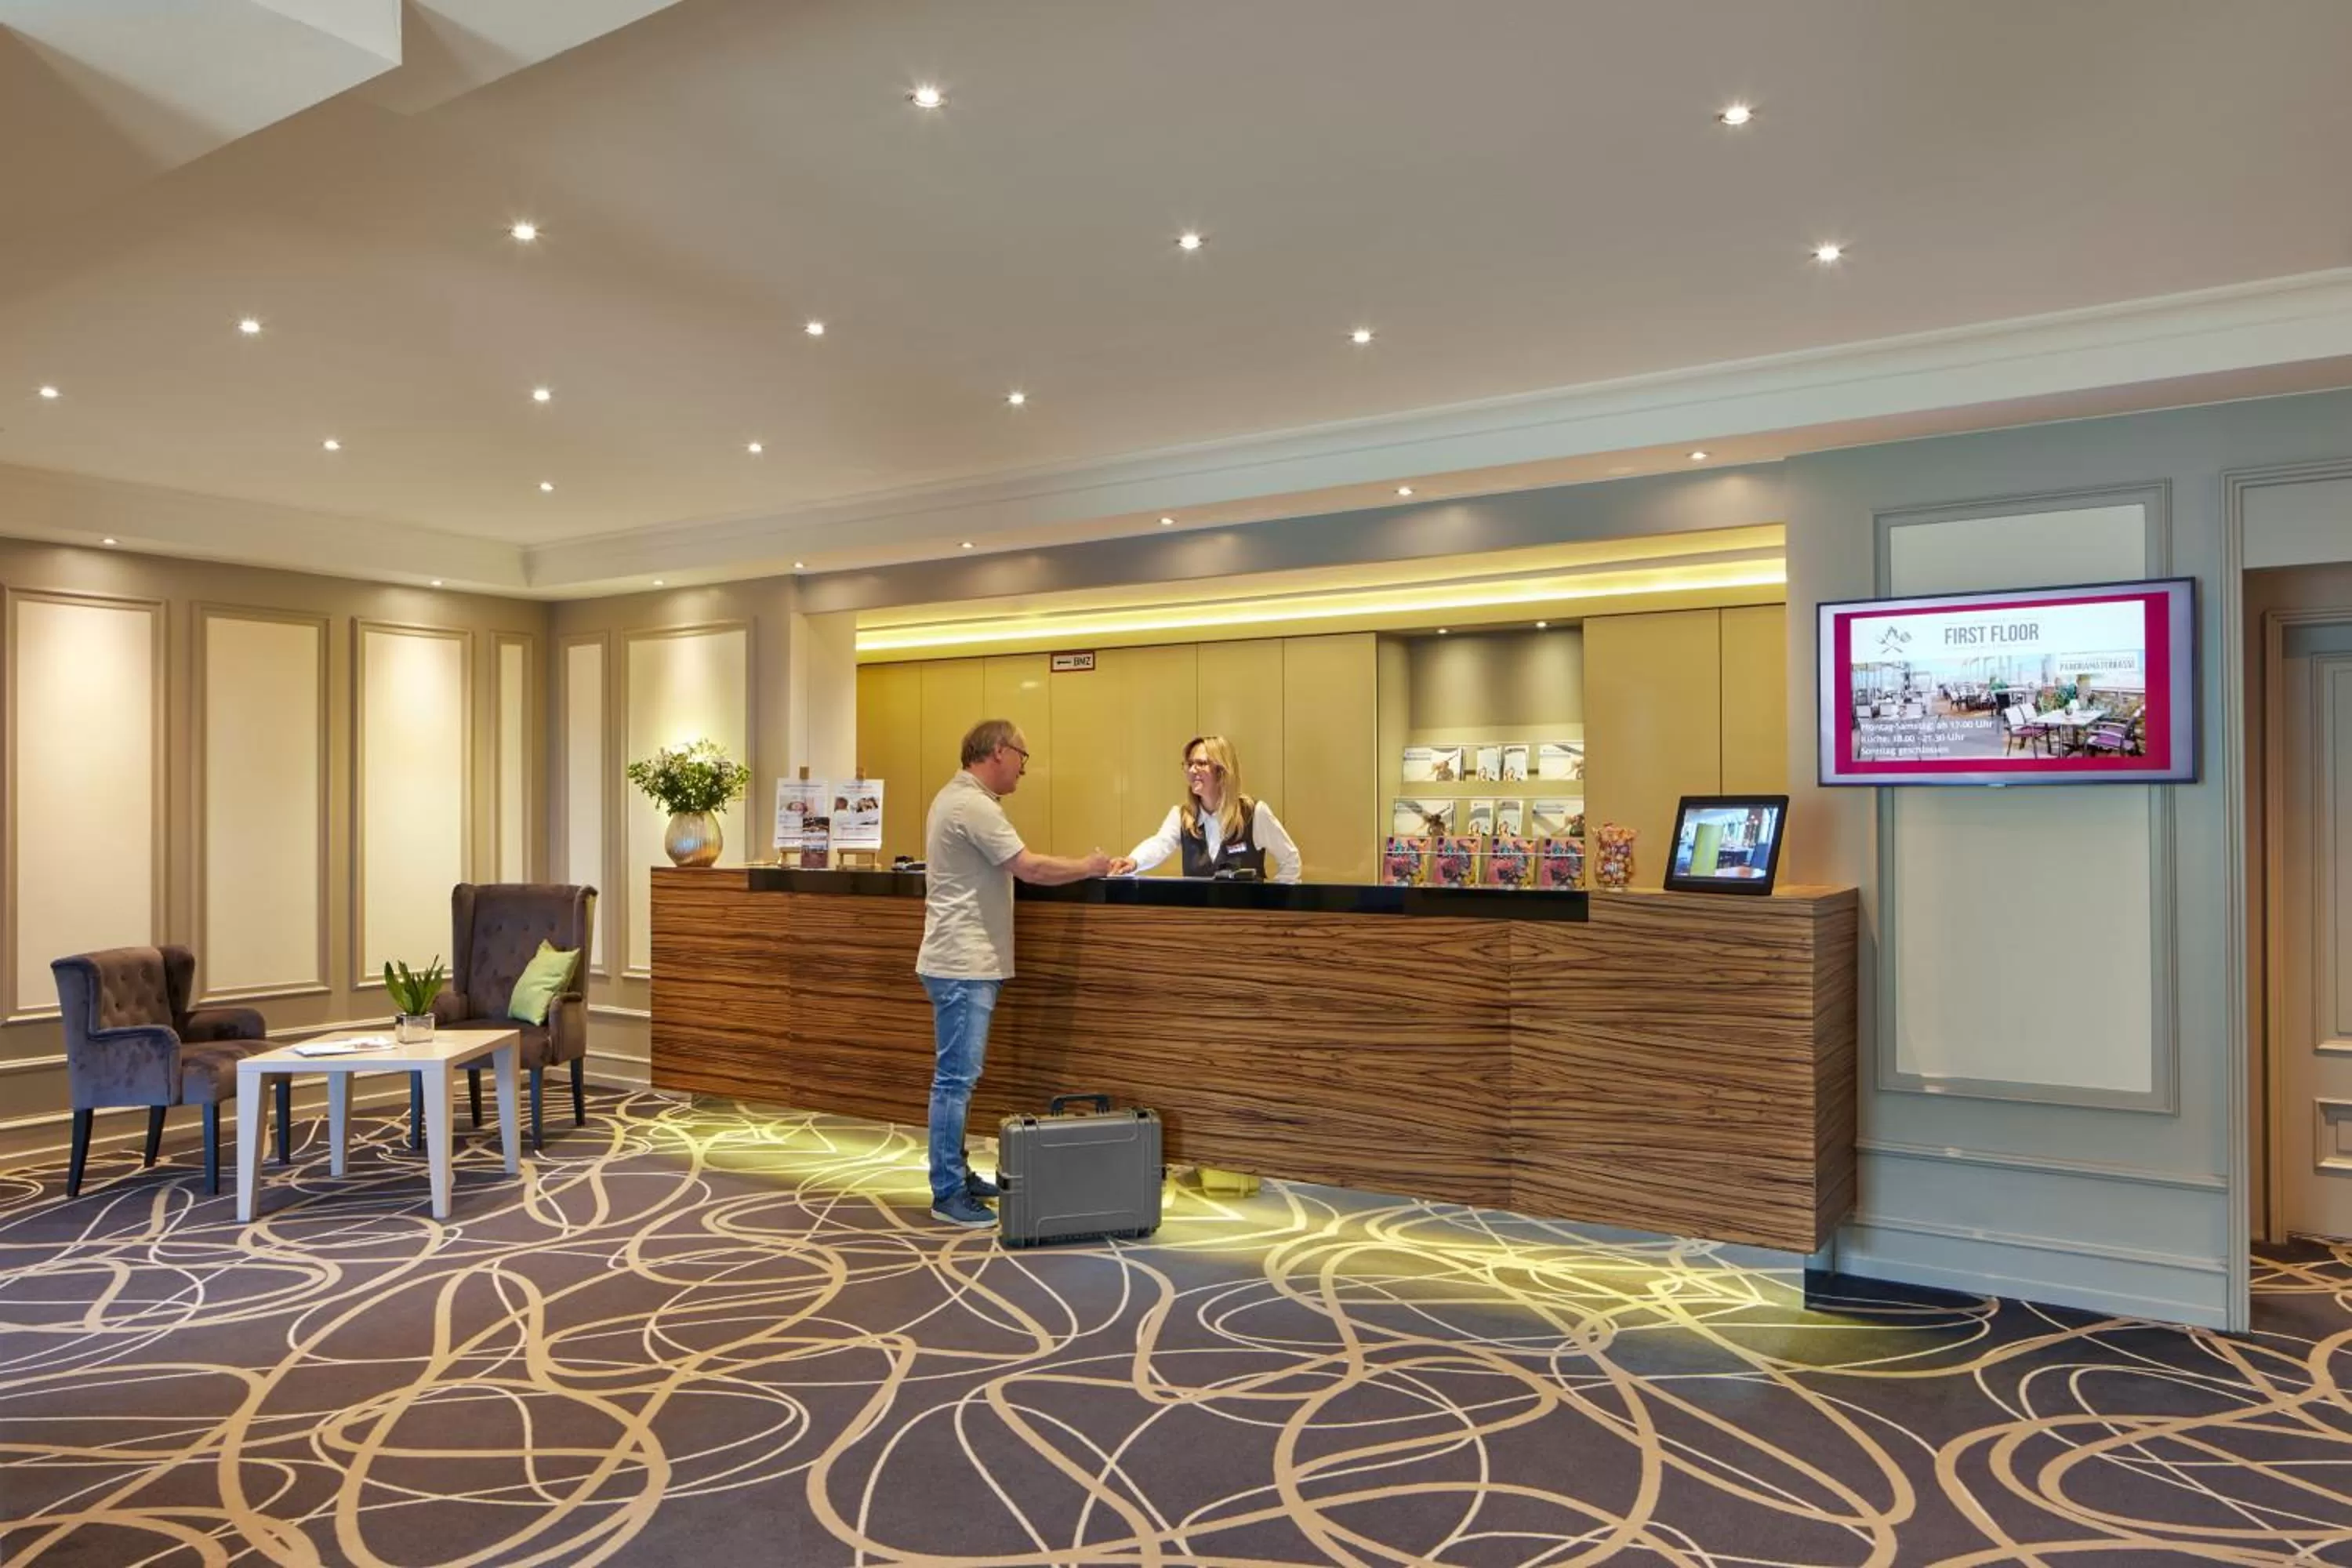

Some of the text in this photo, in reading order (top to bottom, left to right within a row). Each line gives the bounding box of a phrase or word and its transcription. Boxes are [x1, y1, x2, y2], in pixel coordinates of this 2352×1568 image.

[1944, 623, 2039, 644] FIRST FLOOR
[1975, 719, 1993, 728] Uhr
[1947, 732, 1965, 742] Uhr
